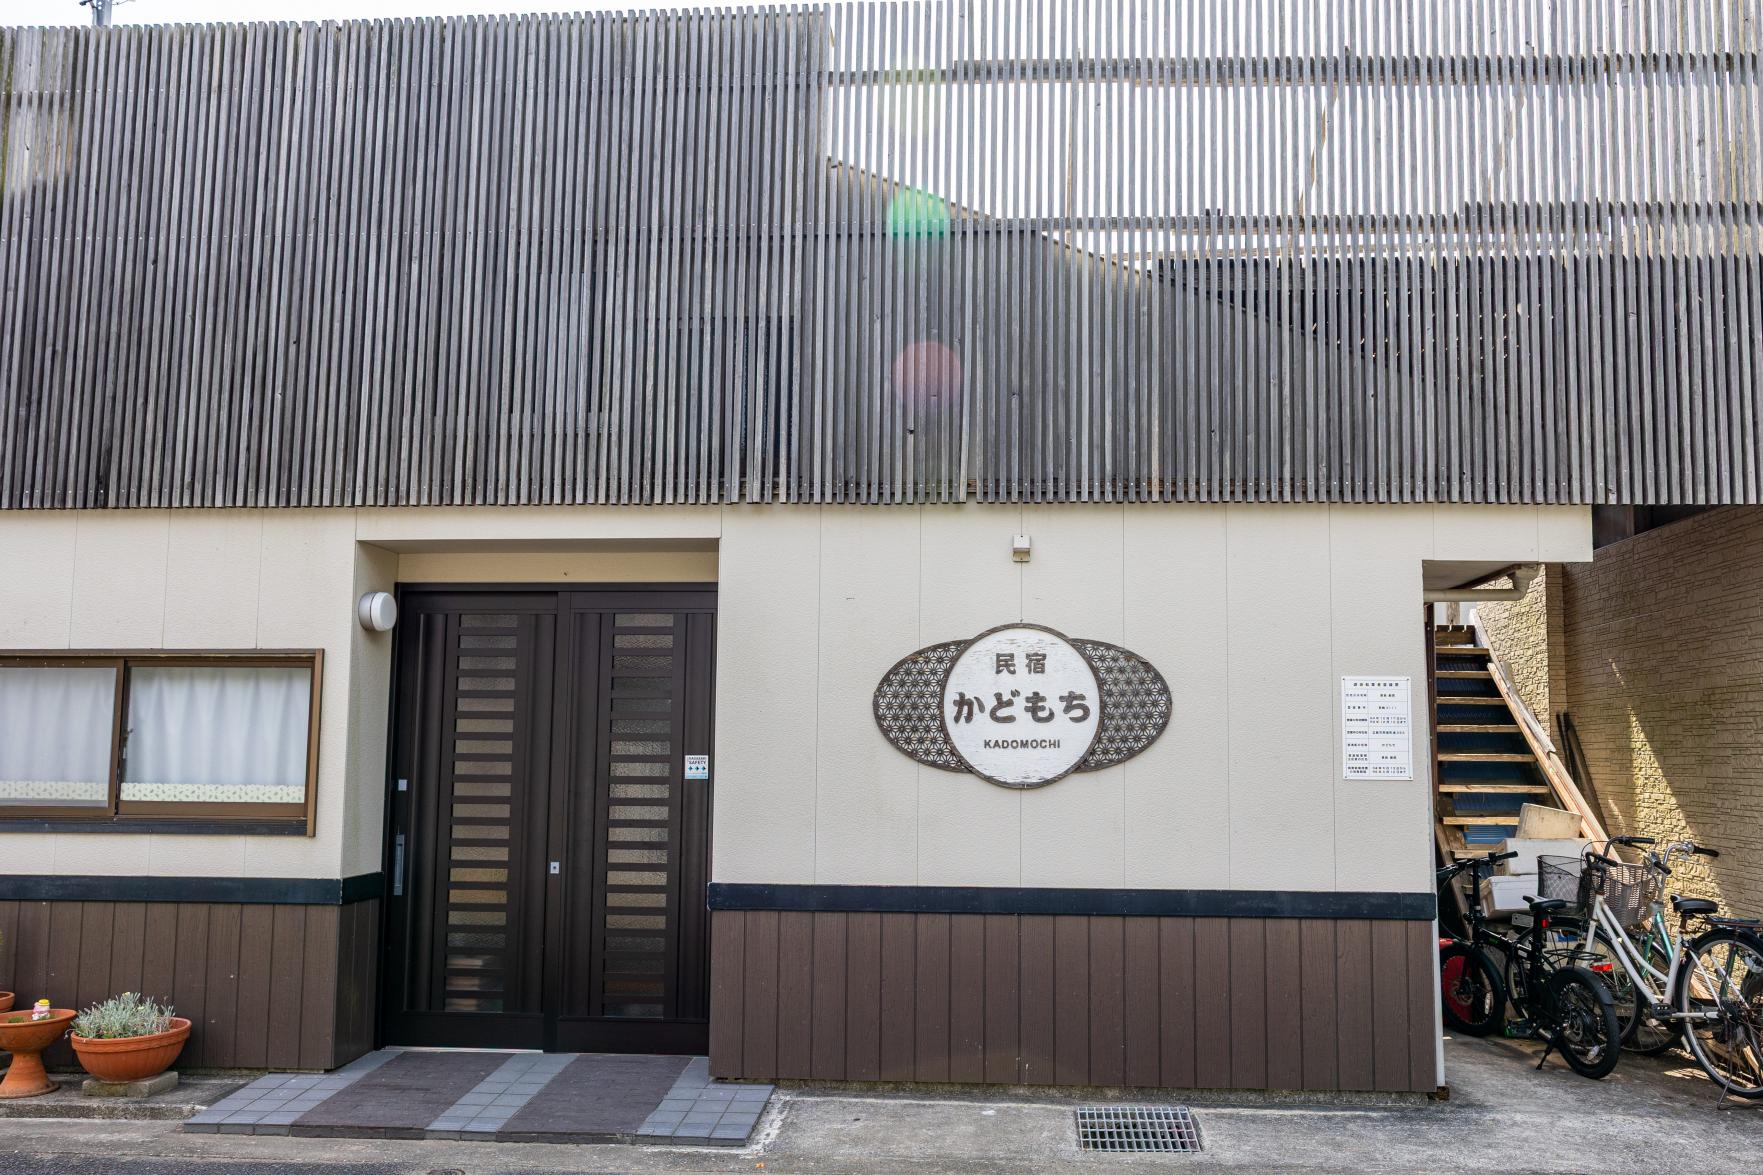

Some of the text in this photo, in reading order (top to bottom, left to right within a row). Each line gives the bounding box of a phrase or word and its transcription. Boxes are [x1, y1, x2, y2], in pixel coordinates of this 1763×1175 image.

[995, 652, 1047, 675] 民宿
[952, 689, 1091, 724] かどもち
[984, 739, 1061, 750] KADOMOCHI
